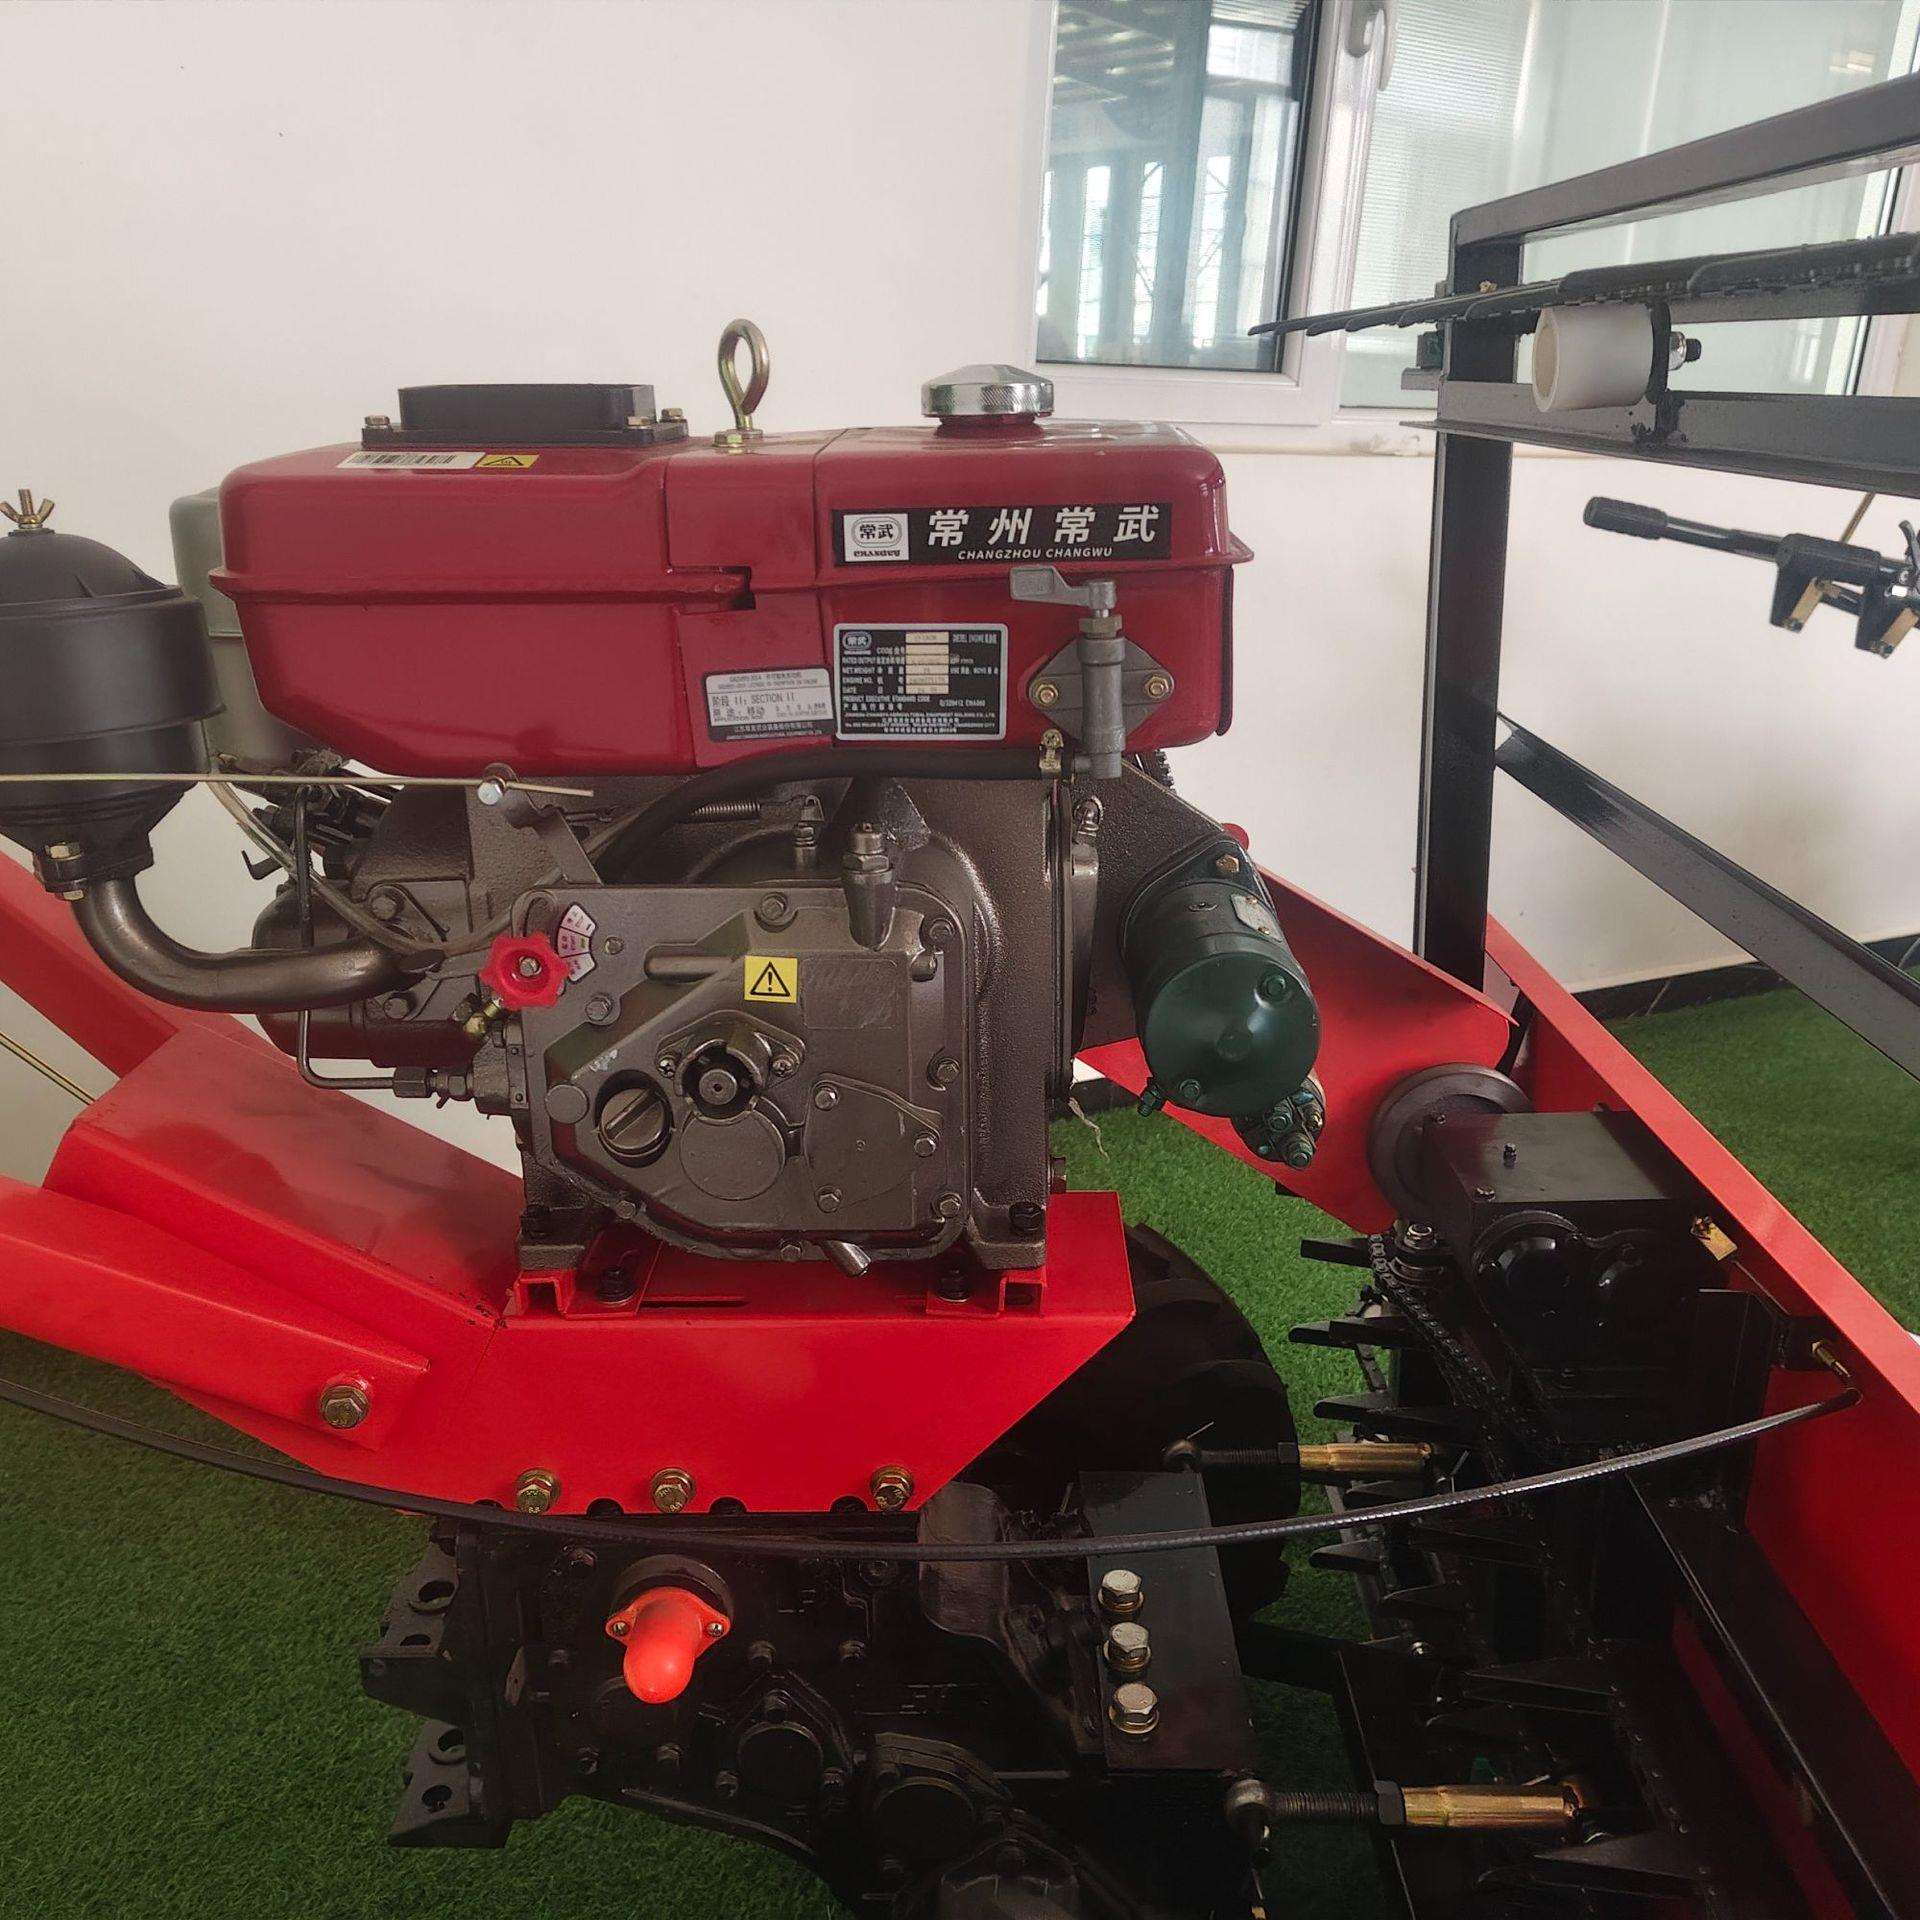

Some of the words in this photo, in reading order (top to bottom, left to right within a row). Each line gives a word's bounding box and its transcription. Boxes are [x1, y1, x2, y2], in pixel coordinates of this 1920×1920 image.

[859, 523, 894, 540] 常武
[927, 503, 1160, 548] 常州常武
[957, 547, 1042, 560] CHANGZHOU
[1045, 546, 1113, 558] CHANGWU
[751, 694, 783, 704] SECTION
